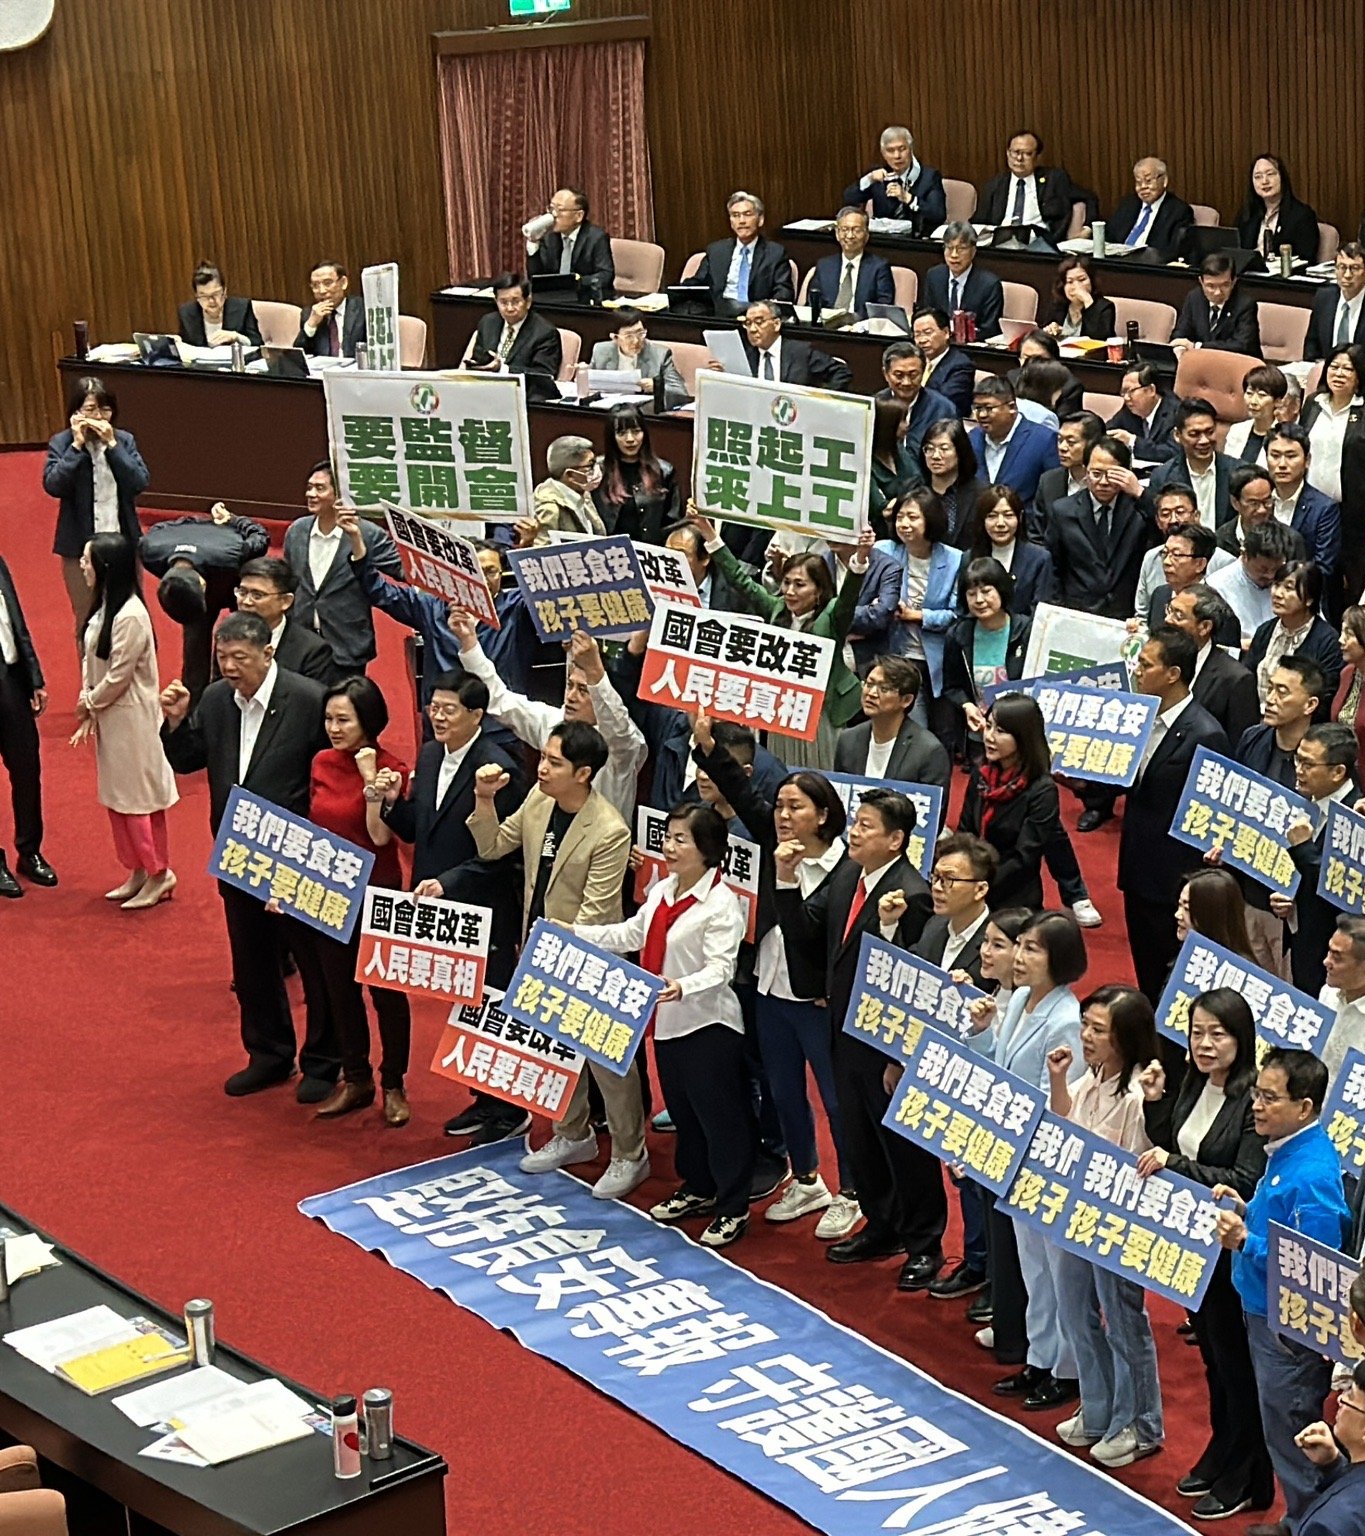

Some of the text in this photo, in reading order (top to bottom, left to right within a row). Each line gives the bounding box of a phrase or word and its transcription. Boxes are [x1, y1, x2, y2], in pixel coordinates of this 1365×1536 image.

[342, 414, 513, 464] 要監督
[706, 418, 858, 484] 照起工
[348, 462, 518, 512] 要開會
[704, 465, 857, 530] 來上工
[388, 508, 478, 575] 國會要改革
[518, 546, 635, 592] 我們要食安
[535, 588, 651, 634] 孩子要健康
[659, 608, 820, 680] 國會要改革
[650, 658, 814, 731] 人民要真相
[1049, 731, 1136, 778] 子要健康
[231, 799, 364, 889] 我們要食安
[1181, 799, 1297, 888] 孩子要健康
[217, 838, 351, 931] 孩子要健康
[368, 893, 484, 949] 國會要改革
[363, 941, 480, 1000] 人民要真相
[531, 931, 652, 1020] 我們要食安
[510, 973, 636, 1065] 孩子要健康
[441, 1034, 569, 1112] 人民要真相
[916, 1039, 1037, 1138] 我們要食安
[895, 1085, 1017, 1185] 孩子要健康
[1083, 1150, 1223, 1246] 我們要食安
[353, 1166, 780, 1376] 堅持食安專報
[1065, 1199, 1208, 1299] 孩子要健康
